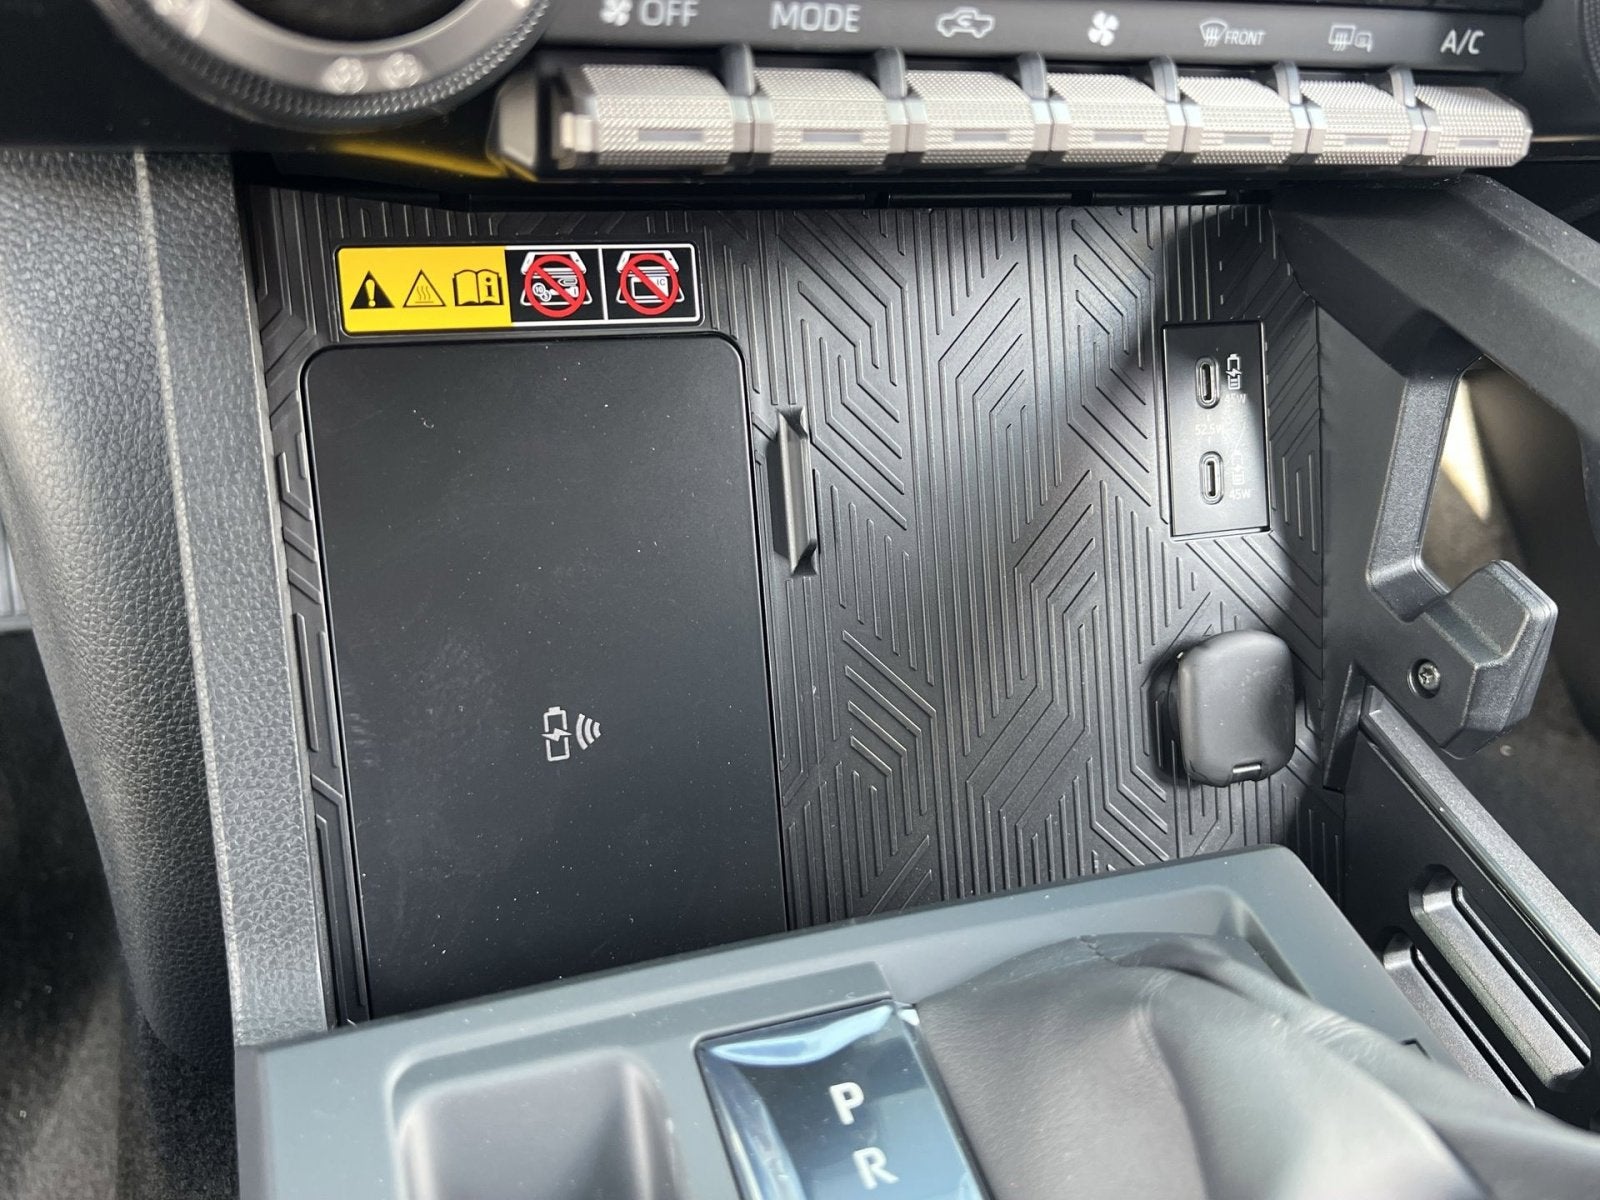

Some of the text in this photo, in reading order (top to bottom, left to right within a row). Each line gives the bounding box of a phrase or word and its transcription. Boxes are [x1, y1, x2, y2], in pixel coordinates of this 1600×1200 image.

[638, 0, 698, 27] OFF
[770, 2, 861, 33] MODE
[1224, 30, 1266, 46] FRONT
[1440, 29, 1485, 55] A/C
[1229, 488, 1251, 500] 45W
[829, 1081, 865, 1126] P
[852, 1146, 899, 1191] R
